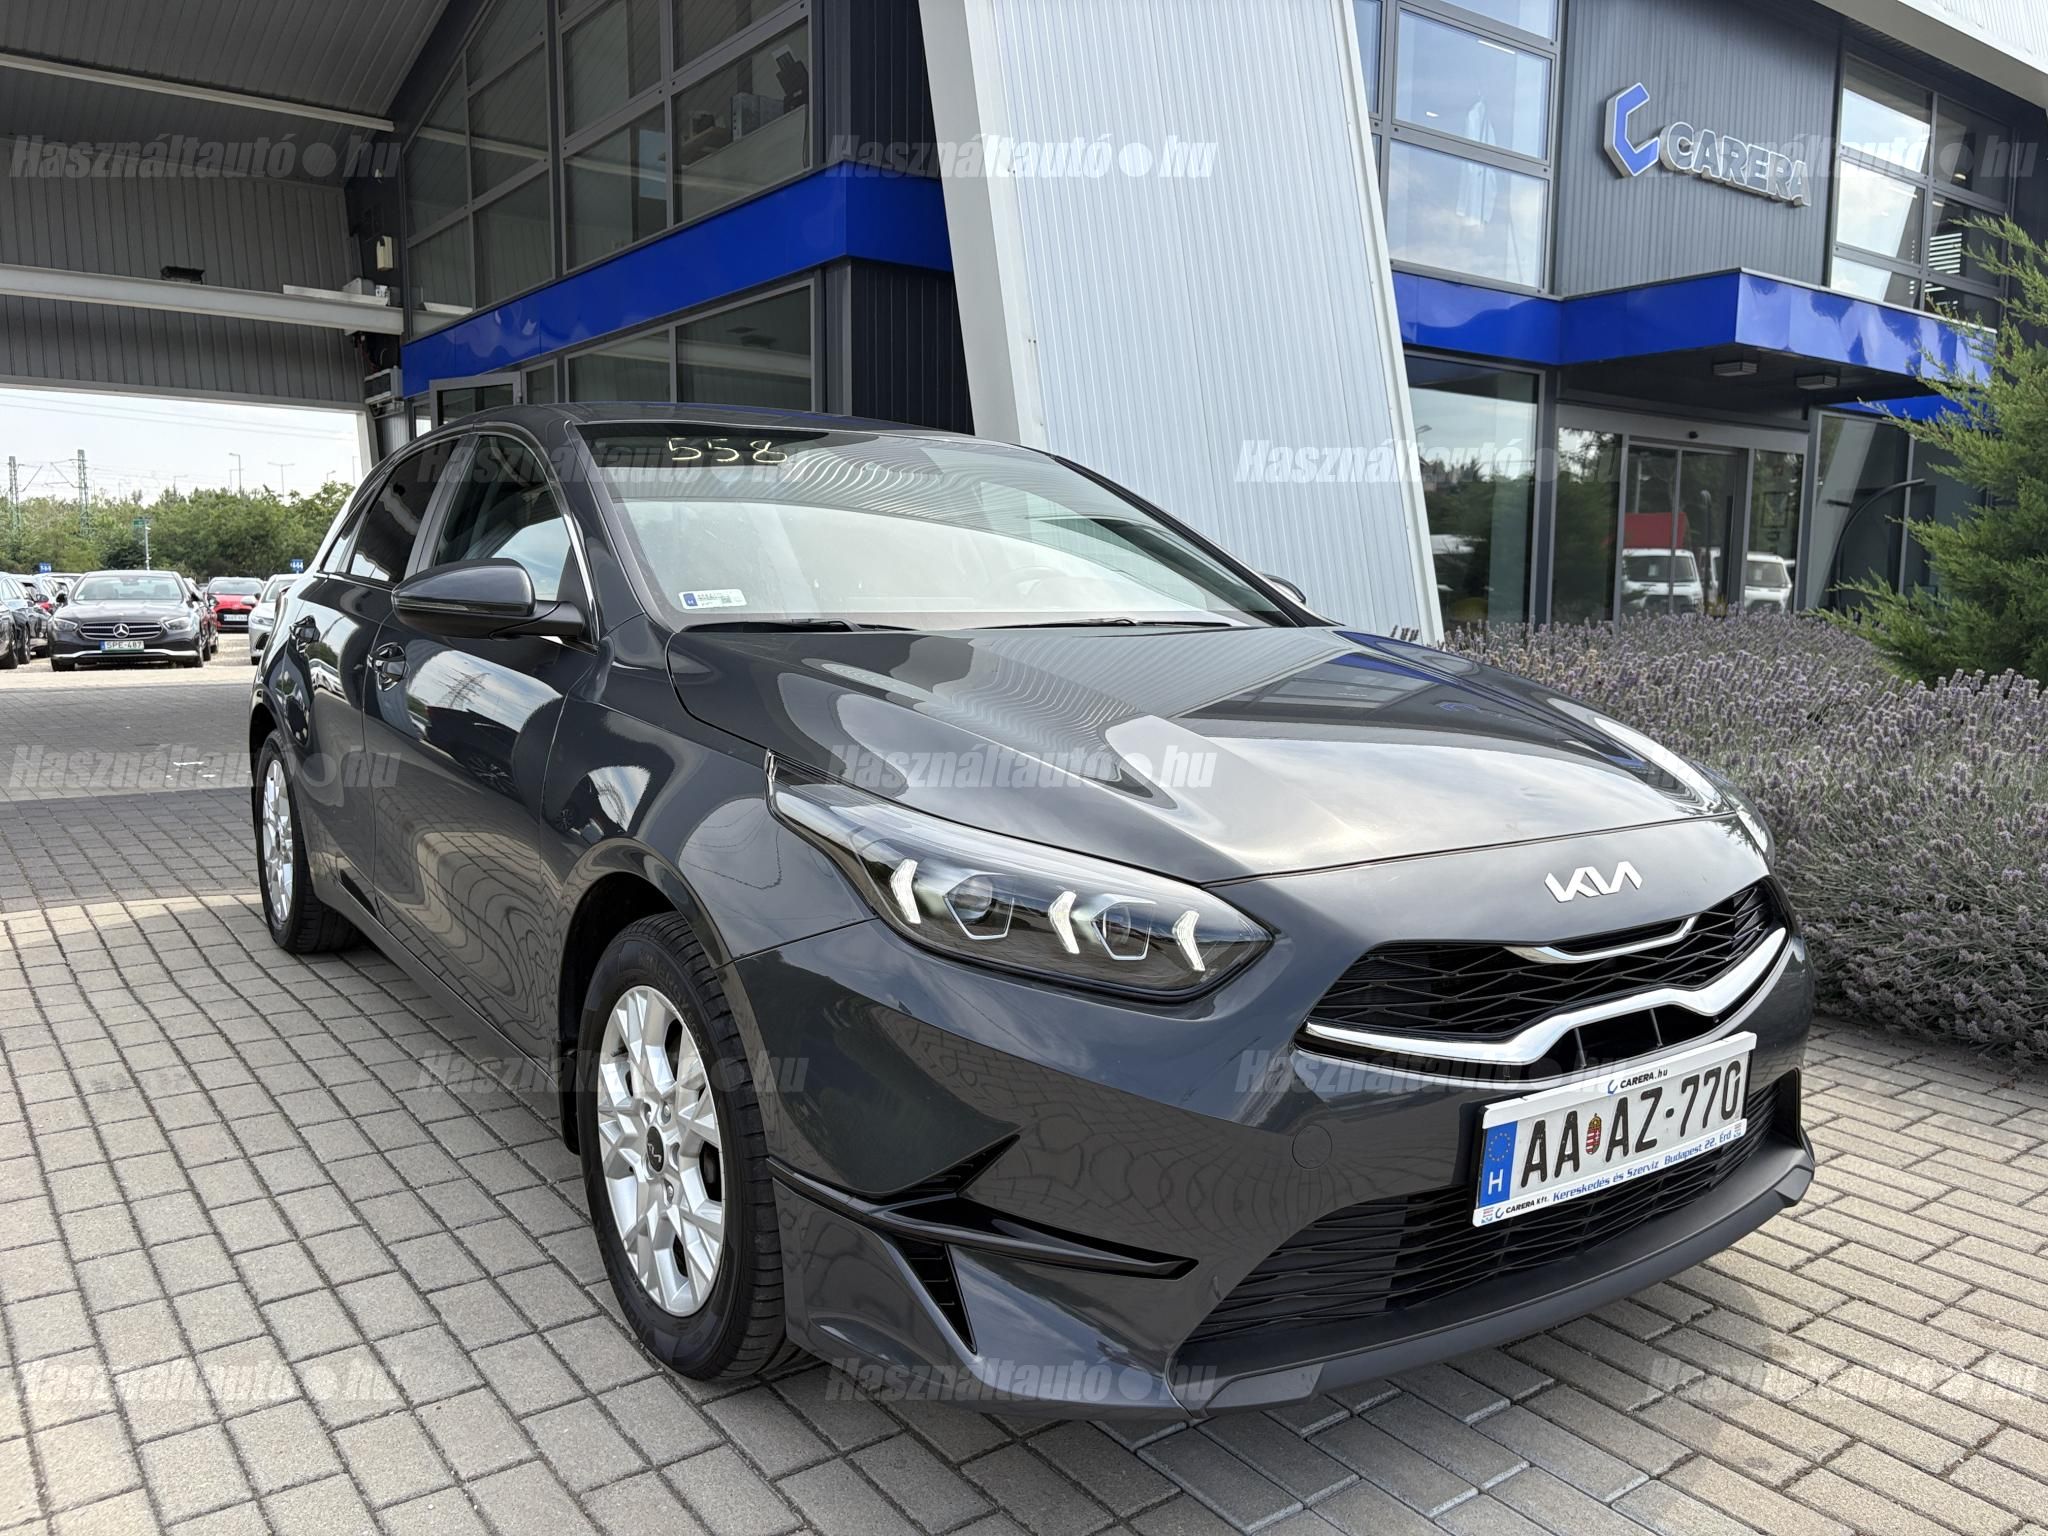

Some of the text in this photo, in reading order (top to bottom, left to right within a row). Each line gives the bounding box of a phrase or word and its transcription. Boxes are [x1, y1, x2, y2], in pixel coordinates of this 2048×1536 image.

[1661, 121, 1811, 207] CARERA
[667, 437, 788, 463] 558
[1487, 1168, 1504, 1196] H
[1505, 1199, 1535, 1214] CARERA
[1552, 1176, 1611, 1202] Kereskedés
[1612, 1172, 1624, 1184] és
[1664, 1143, 1703, 1167] Budapest
